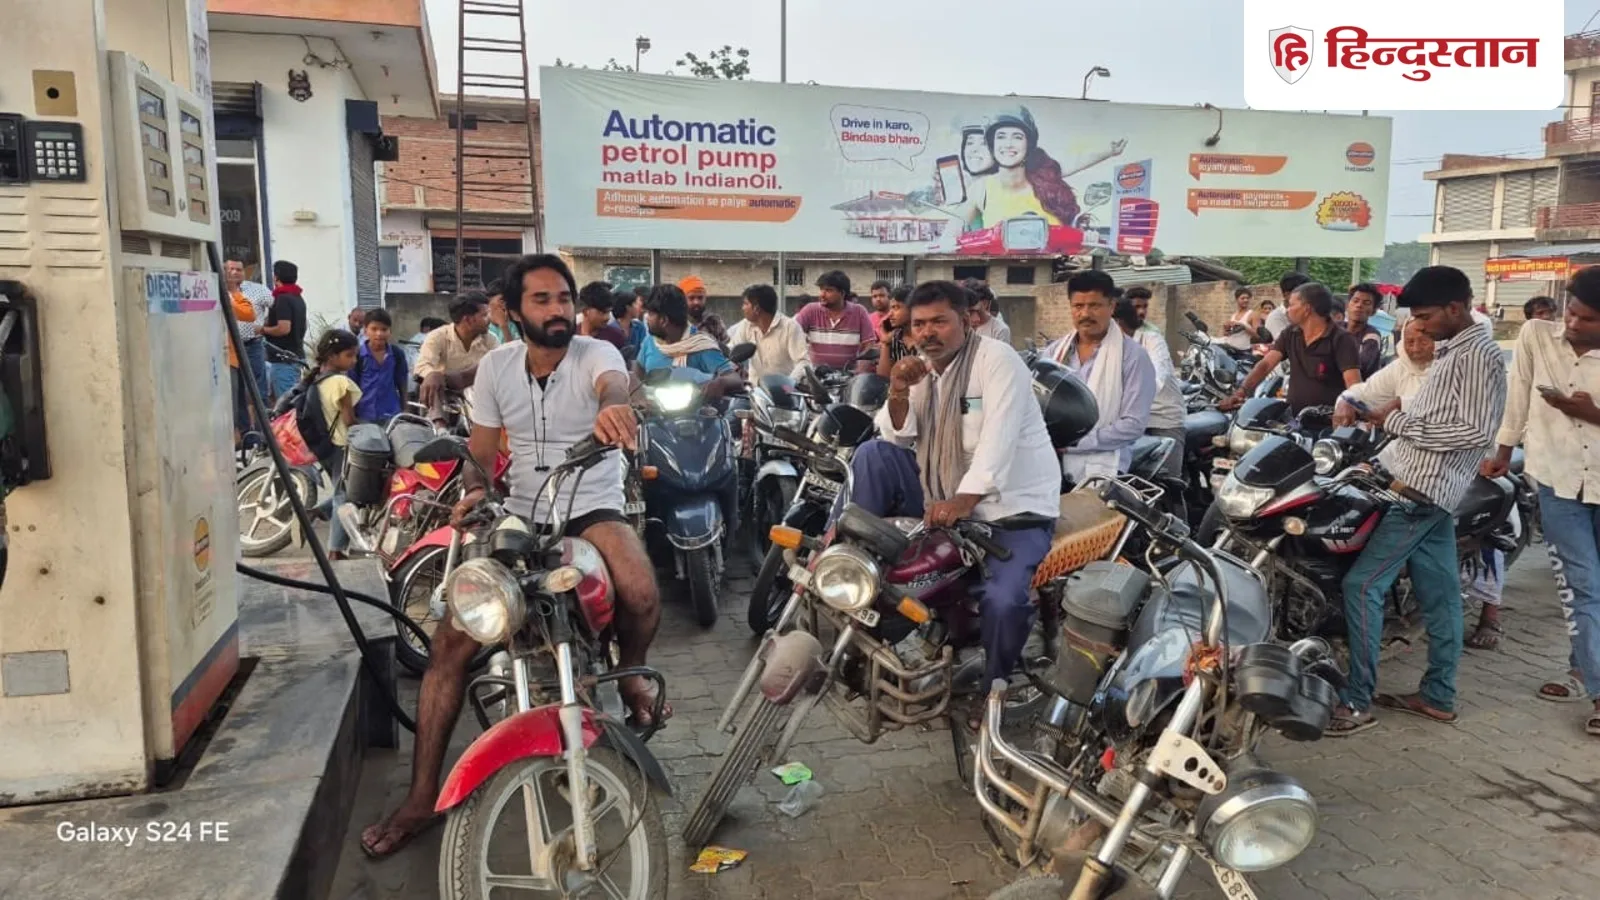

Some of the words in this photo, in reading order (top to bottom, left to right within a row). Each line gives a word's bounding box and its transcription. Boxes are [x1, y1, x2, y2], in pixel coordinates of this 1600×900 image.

[602, 110, 776, 146] Automatic
[841, 117, 871, 129] Drive
[873, 118, 883, 129] in
[885, 119, 913, 132] karo,
[841, 131, 887, 144] Bindaas
[888, 133, 923, 145] bharo.
[602, 143, 688, 166] petrol
[697, 149, 777, 173] pump
[602, 169, 677, 186] matlab
[685, 171, 783, 190] IndianOil.
[603, 191, 647, 204] Adhunik
[648, 192, 705, 207] automation
[706, 196, 719, 206] se
[748, 197, 796, 208] automatic
[146, 272, 185, 299] DIESEL
